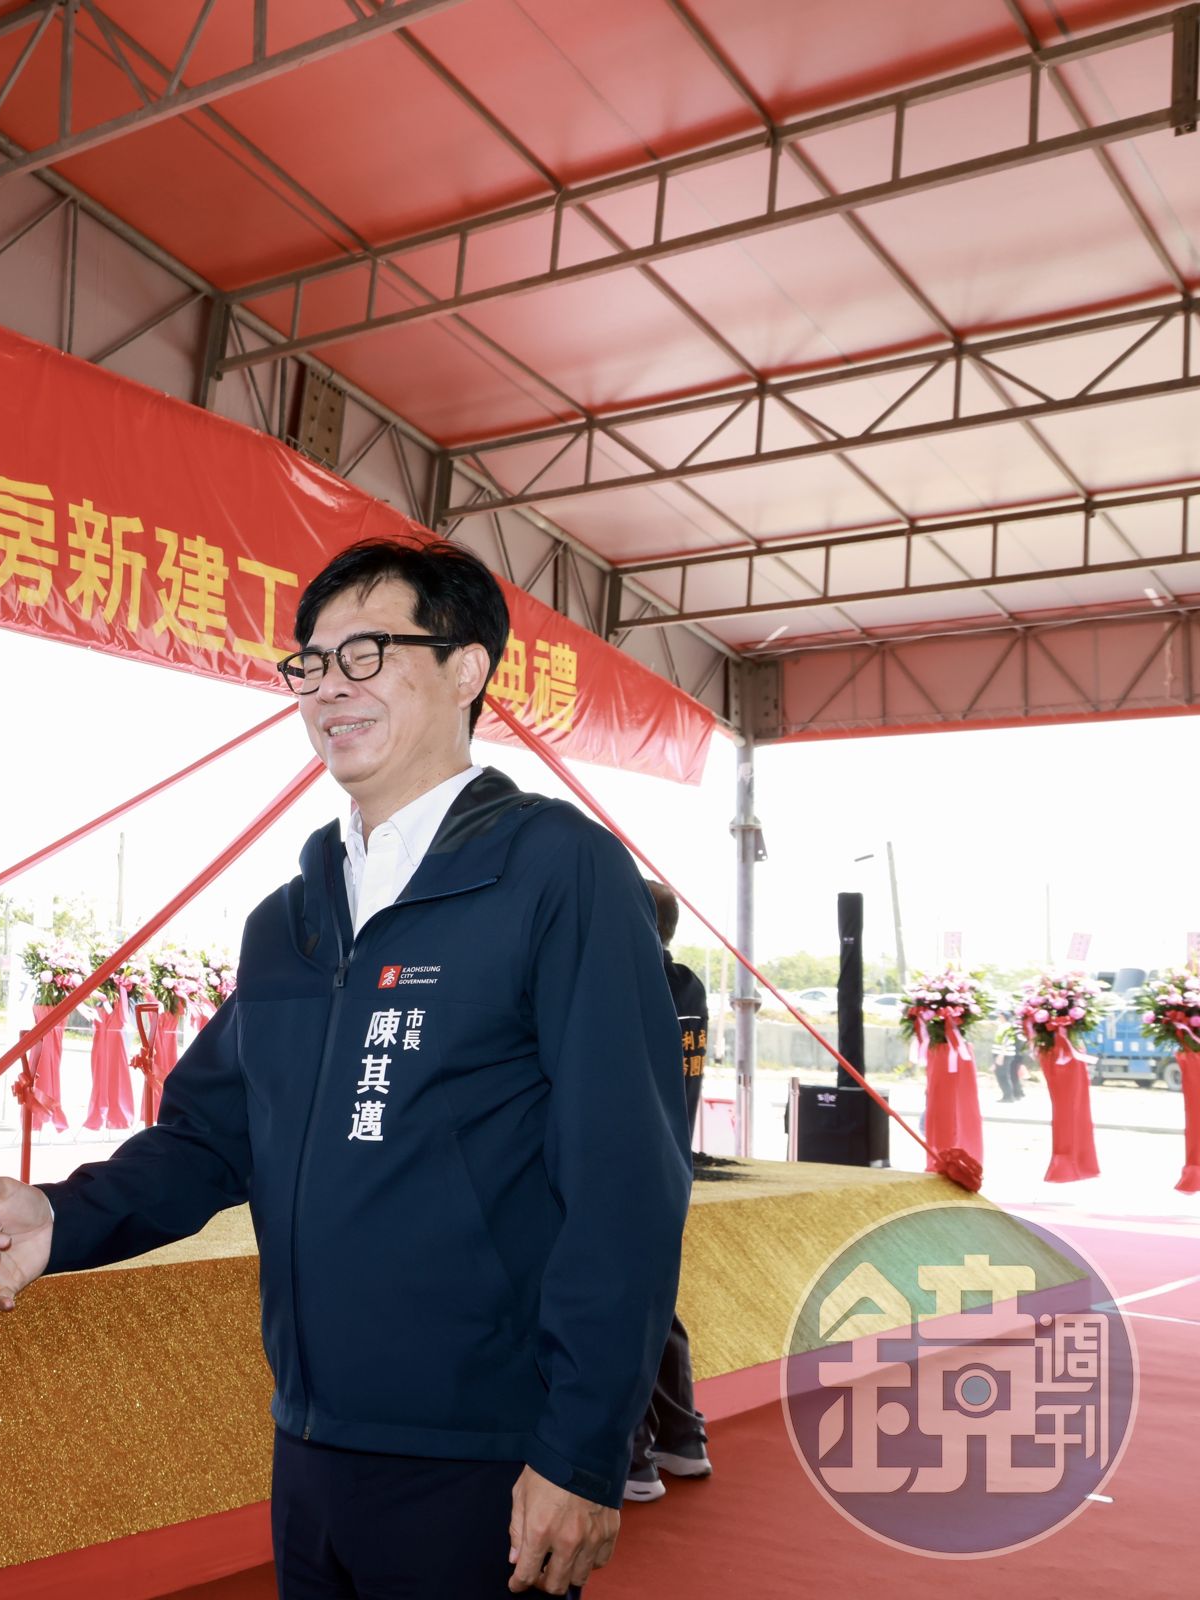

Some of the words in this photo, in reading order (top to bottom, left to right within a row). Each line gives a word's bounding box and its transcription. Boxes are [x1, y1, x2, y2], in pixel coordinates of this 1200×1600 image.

[402, 965, 441, 973] KAOHSIUNG
[402, 1008, 426, 1050] 市長
[348, 1008, 402, 1141] 陳其邁
